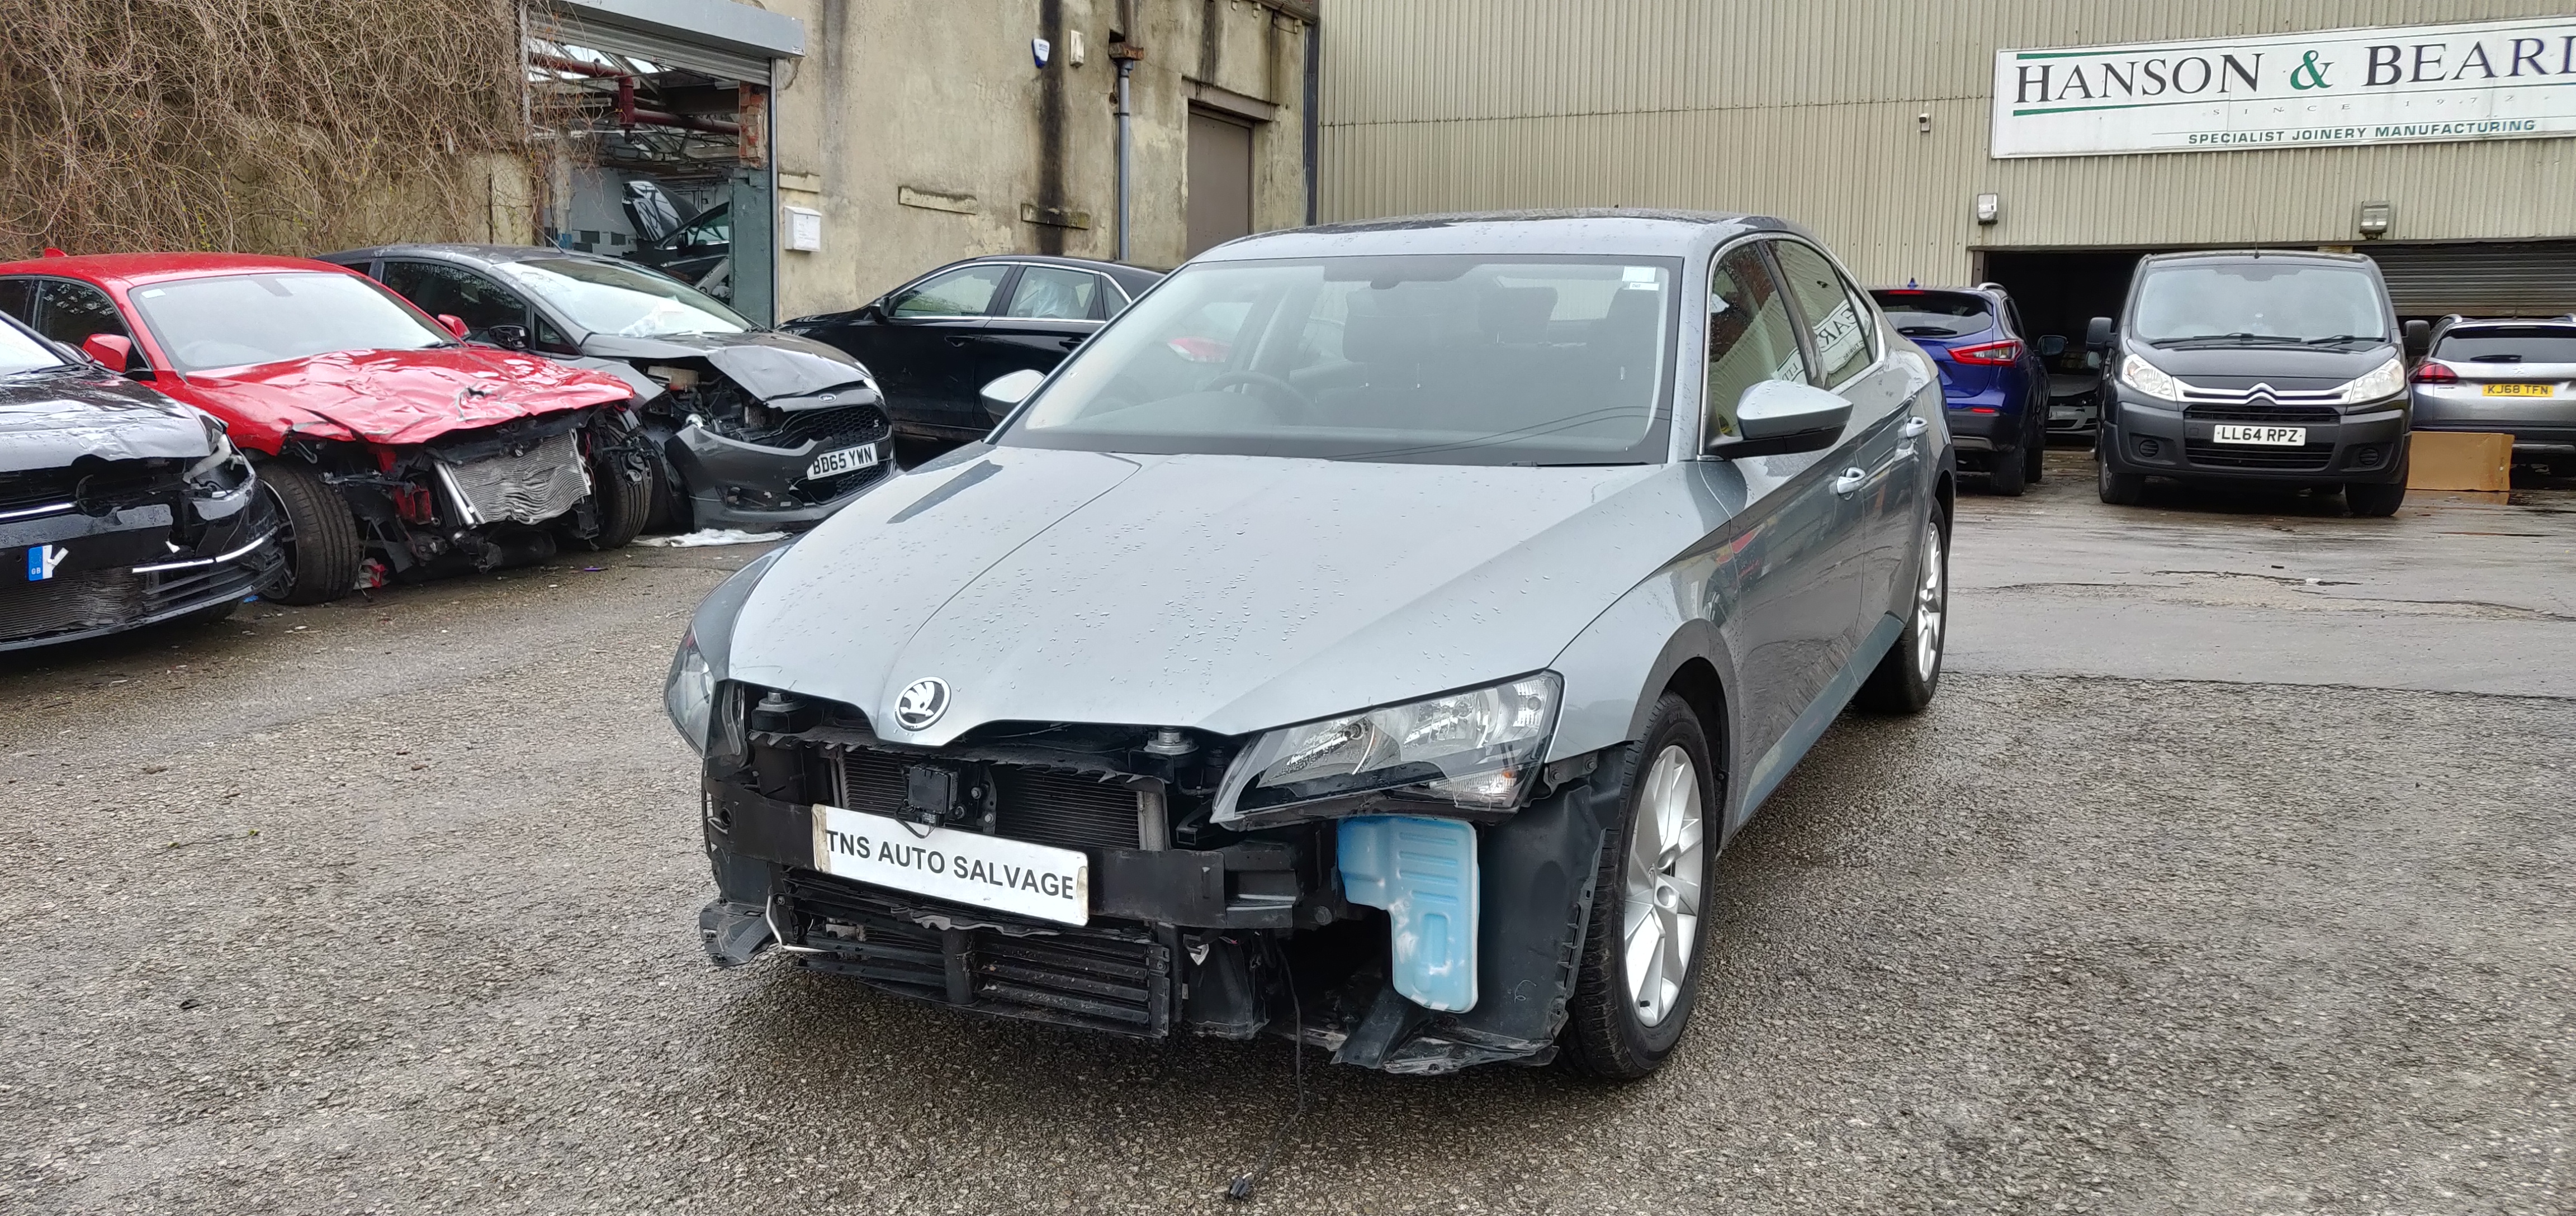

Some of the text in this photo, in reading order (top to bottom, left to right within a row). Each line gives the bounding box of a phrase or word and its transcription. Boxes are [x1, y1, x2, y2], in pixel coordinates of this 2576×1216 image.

[2014, 52, 2265, 104] HANSON
[2290, 50, 2334, 91] &
[2188, 120, 2536, 144] SPECIALIST JOINERY MANUFACTURING
[2488, 384, 2549, 395] KJ68 TFN
[2222, 426, 2298, 443] LL64 RPZ
[813, 446, 873, 475] BD65 YWN
[31, 567, 41, 575] GB
[826, 829, 1073, 900] TNS AUTO SALVAGE
